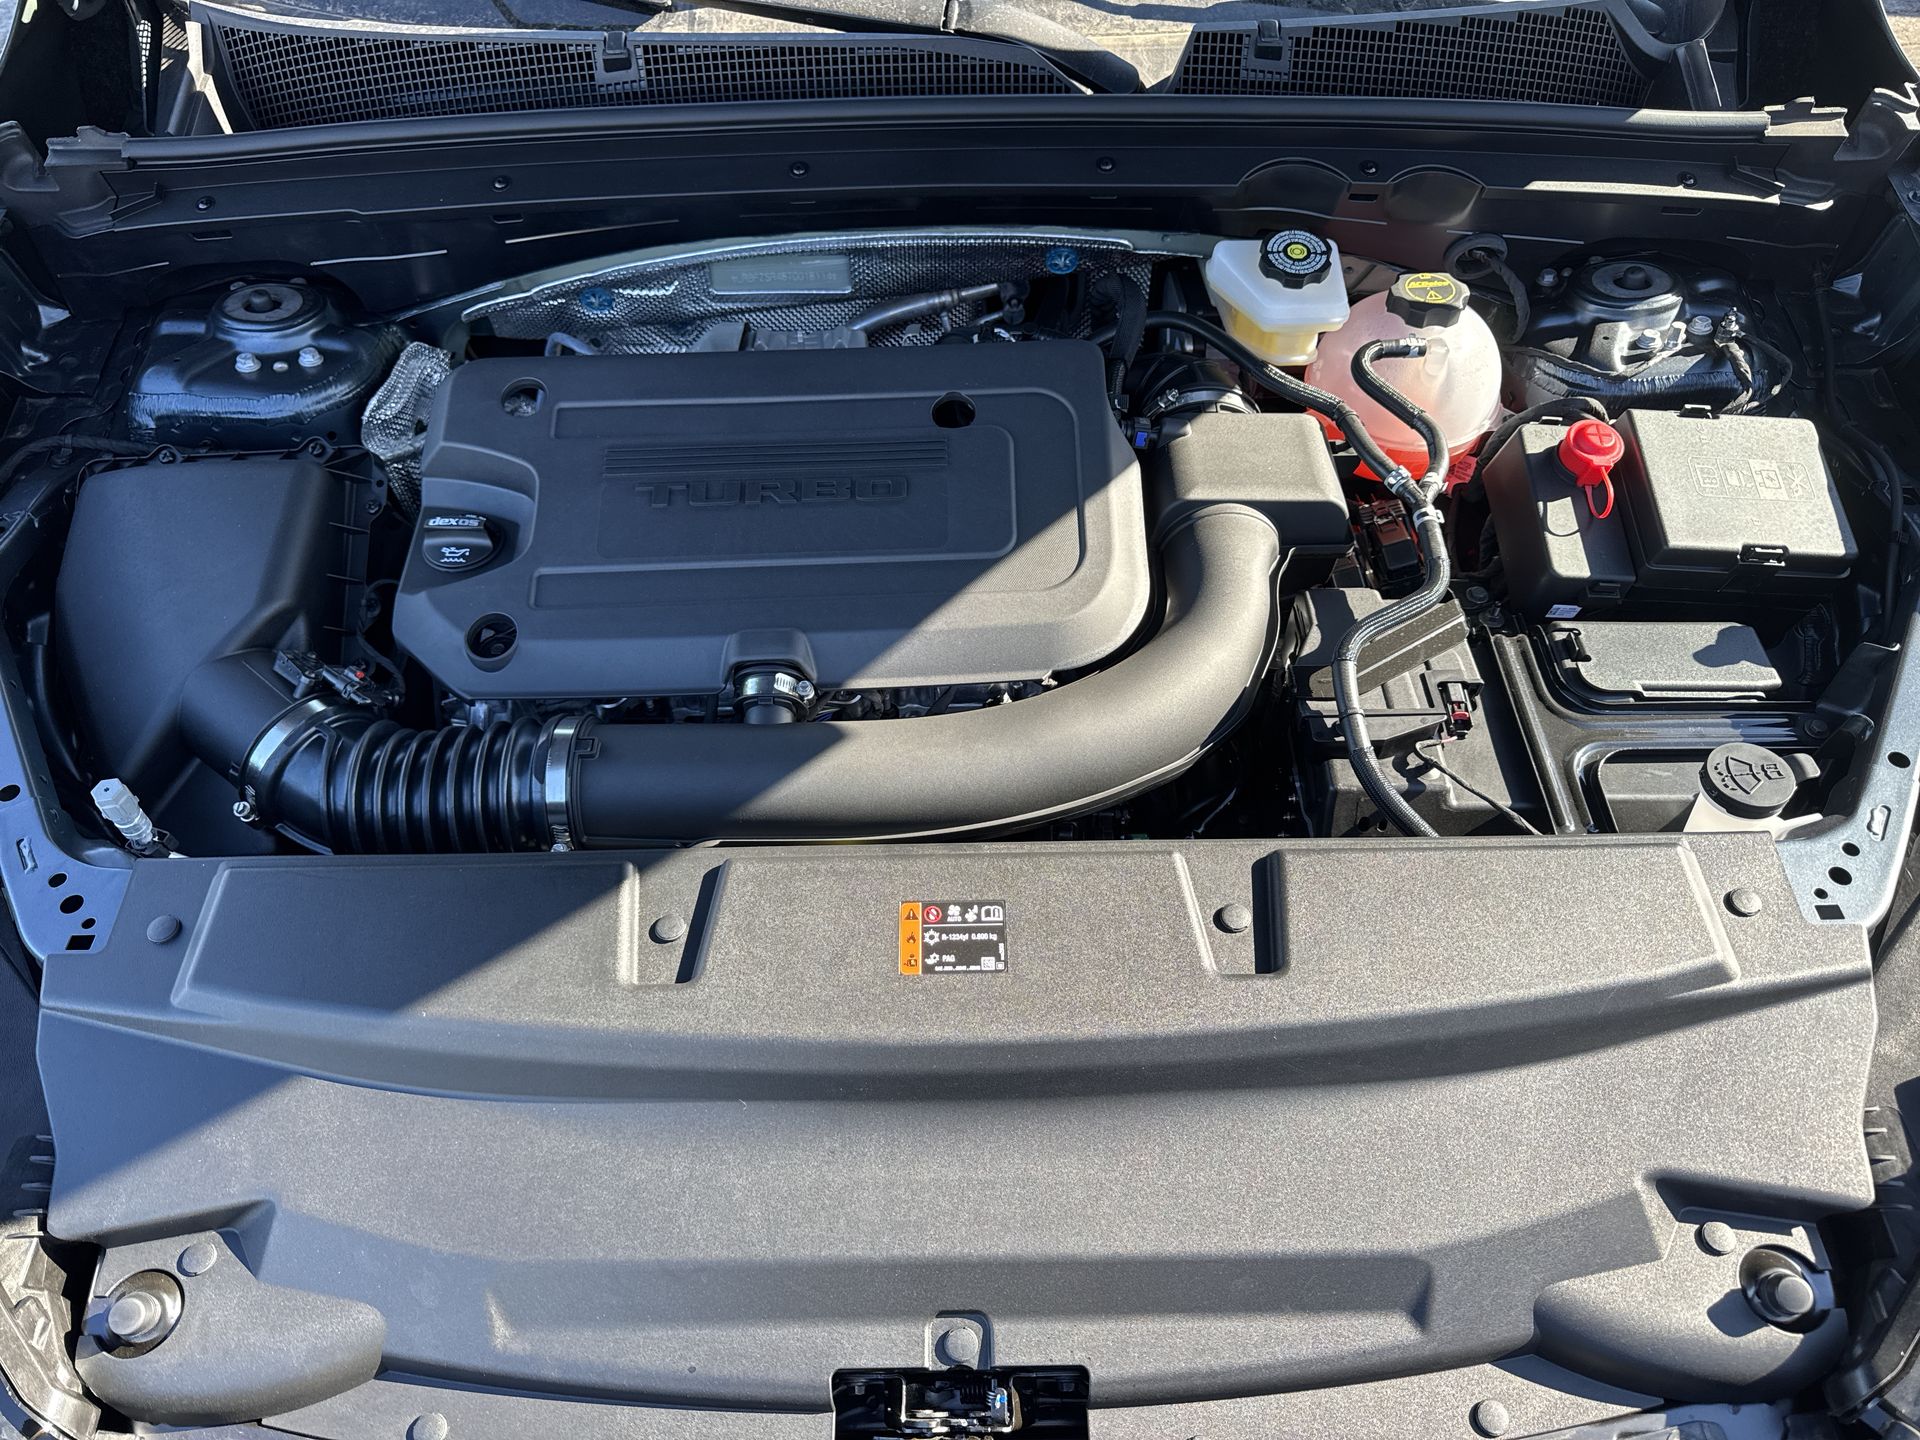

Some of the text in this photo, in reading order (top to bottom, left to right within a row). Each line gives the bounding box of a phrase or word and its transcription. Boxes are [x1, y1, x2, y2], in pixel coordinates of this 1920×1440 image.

[634, 474, 909, 509] TURBO
[428, 516, 480, 527] dexos
[989, 932, 998, 941] kg
